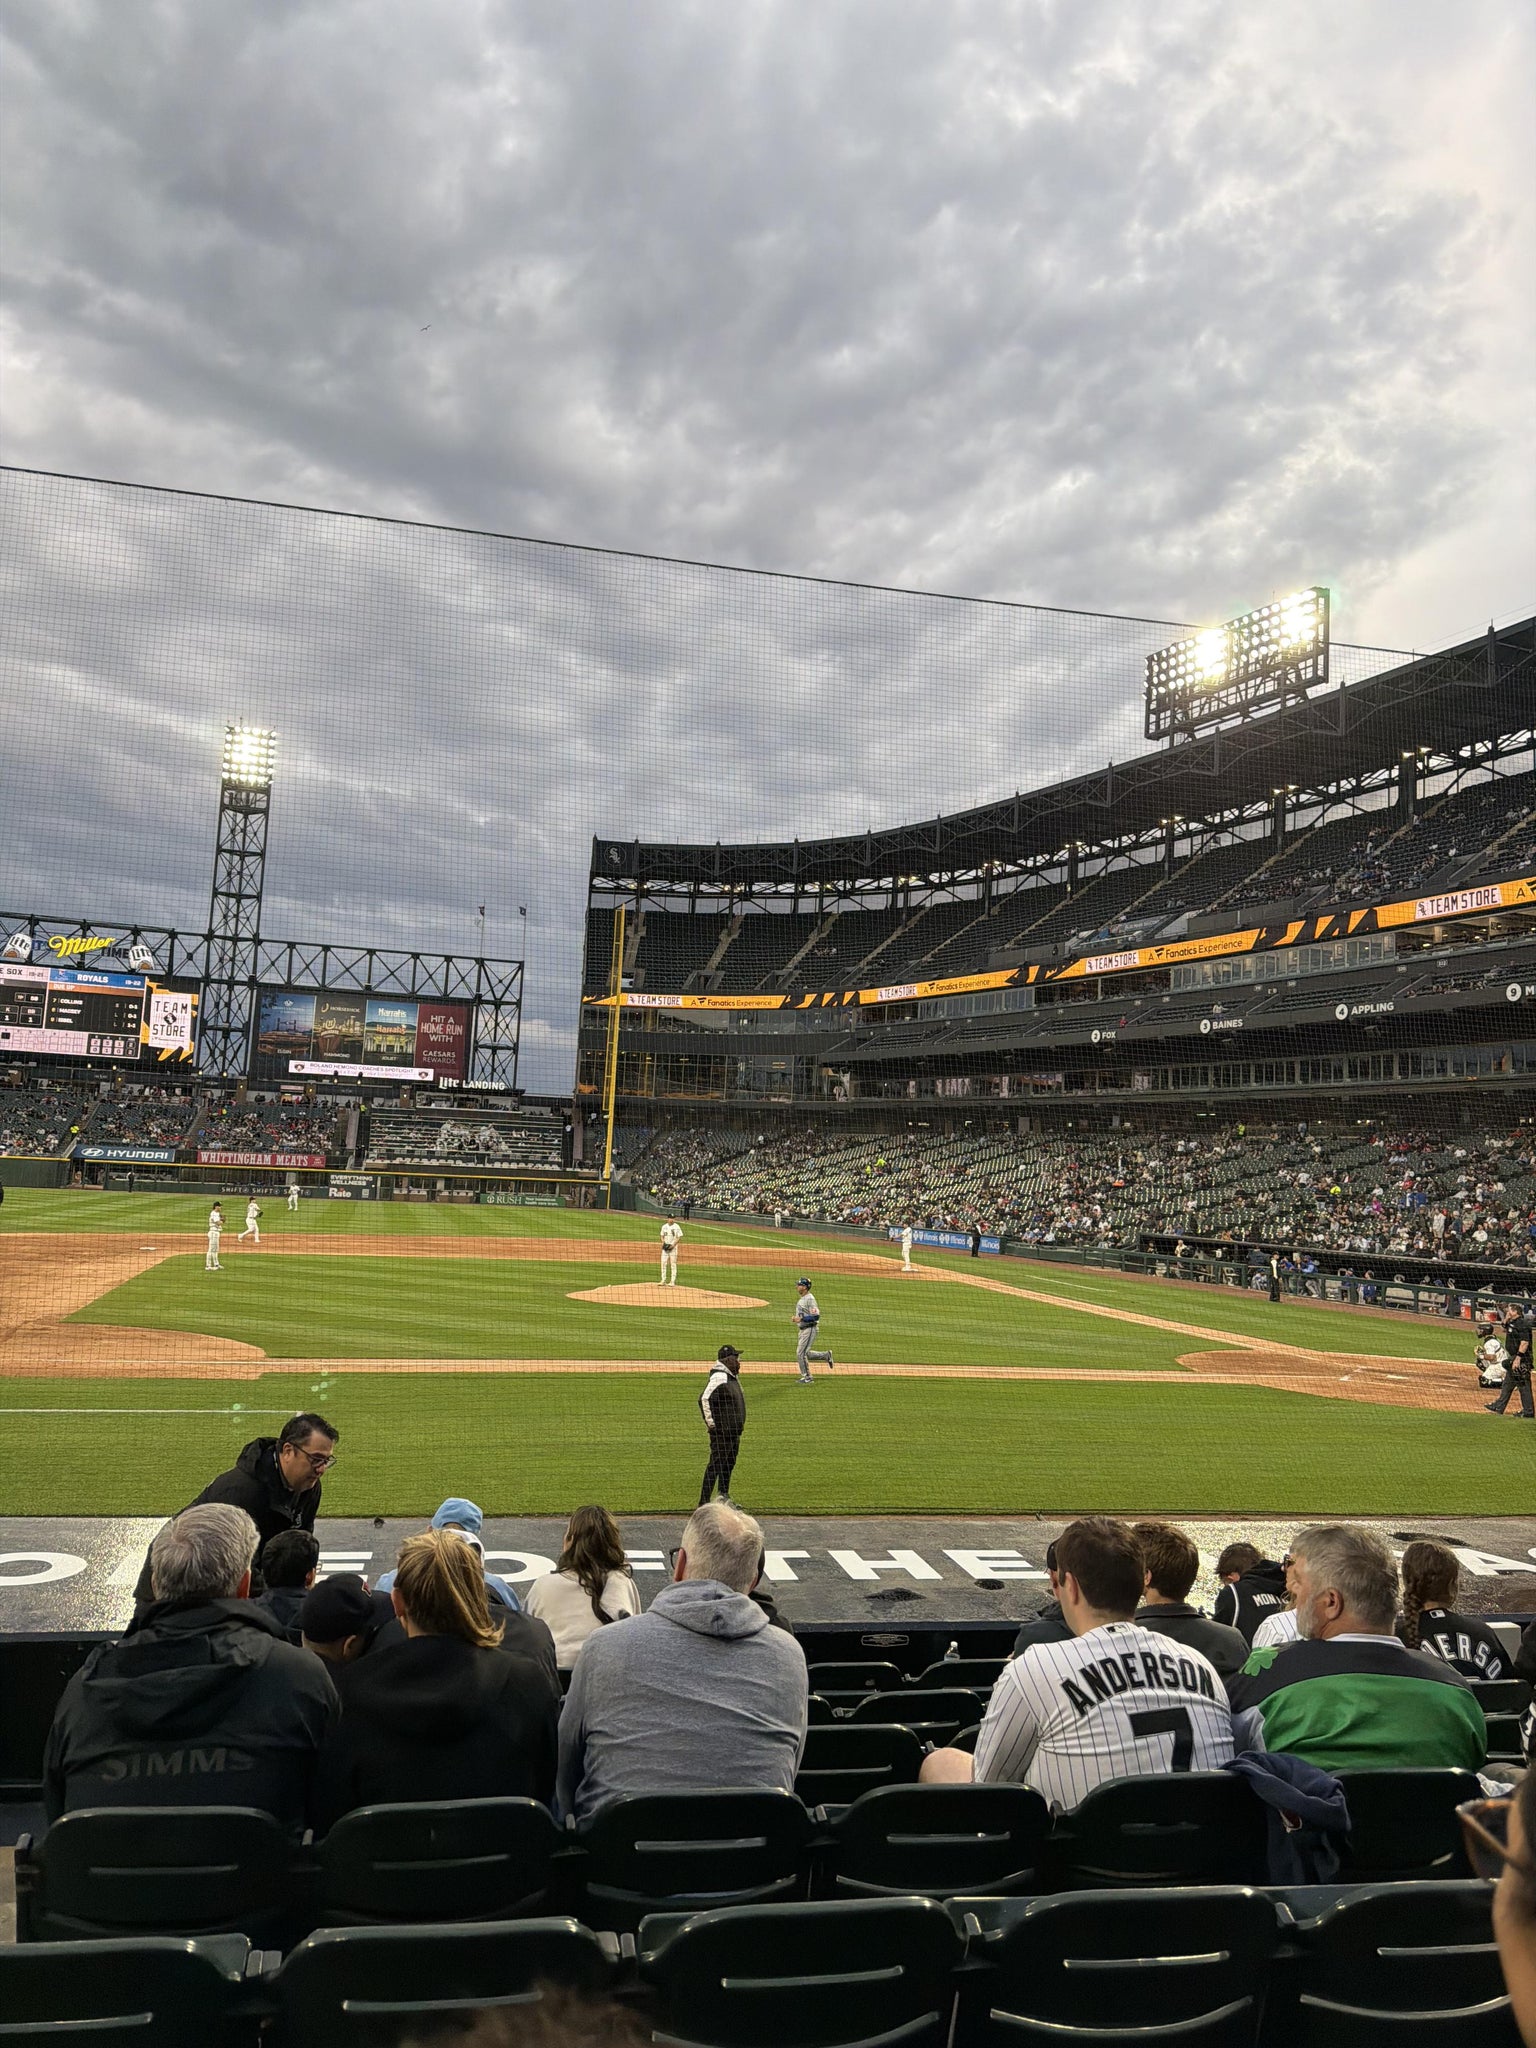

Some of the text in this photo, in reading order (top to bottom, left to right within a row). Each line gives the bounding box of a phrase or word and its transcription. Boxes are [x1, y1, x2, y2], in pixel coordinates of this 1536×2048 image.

[1430, 895, 1459, 915] TEAM
[1461, 888, 1498, 909] STORE
[1516, 888, 1526, 899] A
[9, 936, 30, 951] Lite
[48, 935, 117, 958] Miller
[1094, 957, 1113, 970] TEAM
[1114, 952, 1137, 967] STORE
[1165, 947, 1198, 959] Fanatics
[1198, 939, 1243, 953] Experience
[7, 968, 23, 976] SOX
[77, 974, 109, 983] ROYALS
[884, 988, 898, 998] TEAM
[899, 985, 916, 997] STORE
[935, 983, 958, 992] Fanatics
[958, 979, 990, 989] Experience
[155, 1001, 188, 1014] TEAM
[637, 995, 657, 1004] TEAM
[658, 996, 680, 1006] STORE
[707, 999, 736, 1007] Fanatics
[736, 999, 773, 1008] Experience
[1351, 1002, 1395, 1015] APPLING
[430, 1015, 455, 1024] HIT A
[1212, 1019, 1244, 1030] BAINES
[152, 1024, 185, 1037] STORE
[420, 1022, 463, 1036] HOME RUN
[429, 1034, 454, 1043] WITH
[1102, 1032, 1117, 1040] FOX
[422, 1049, 456, 1058] CAESARS
[439, 1076, 506, 1090] Lite LANDING
[106, 1149, 169, 1160] HYUNDAI
[200, 1151, 272, 1166] WHITTINGHAM
[276, 1154, 309, 1167] MEATS
[330, 1174, 373, 1182] EVERYTHING
[328, 1187, 352, 1198] Rate
[496, 1196, 522, 1205] RUSH
[950, 1236, 966, 1245] Illinois
[982, 1239, 1000, 1249] Illinois
[1060, 1652, 1215, 1717] ANDERSON
[1128, 1706, 1194, 1772] 7
[101, 1748, 255, 1782] SIMMS
